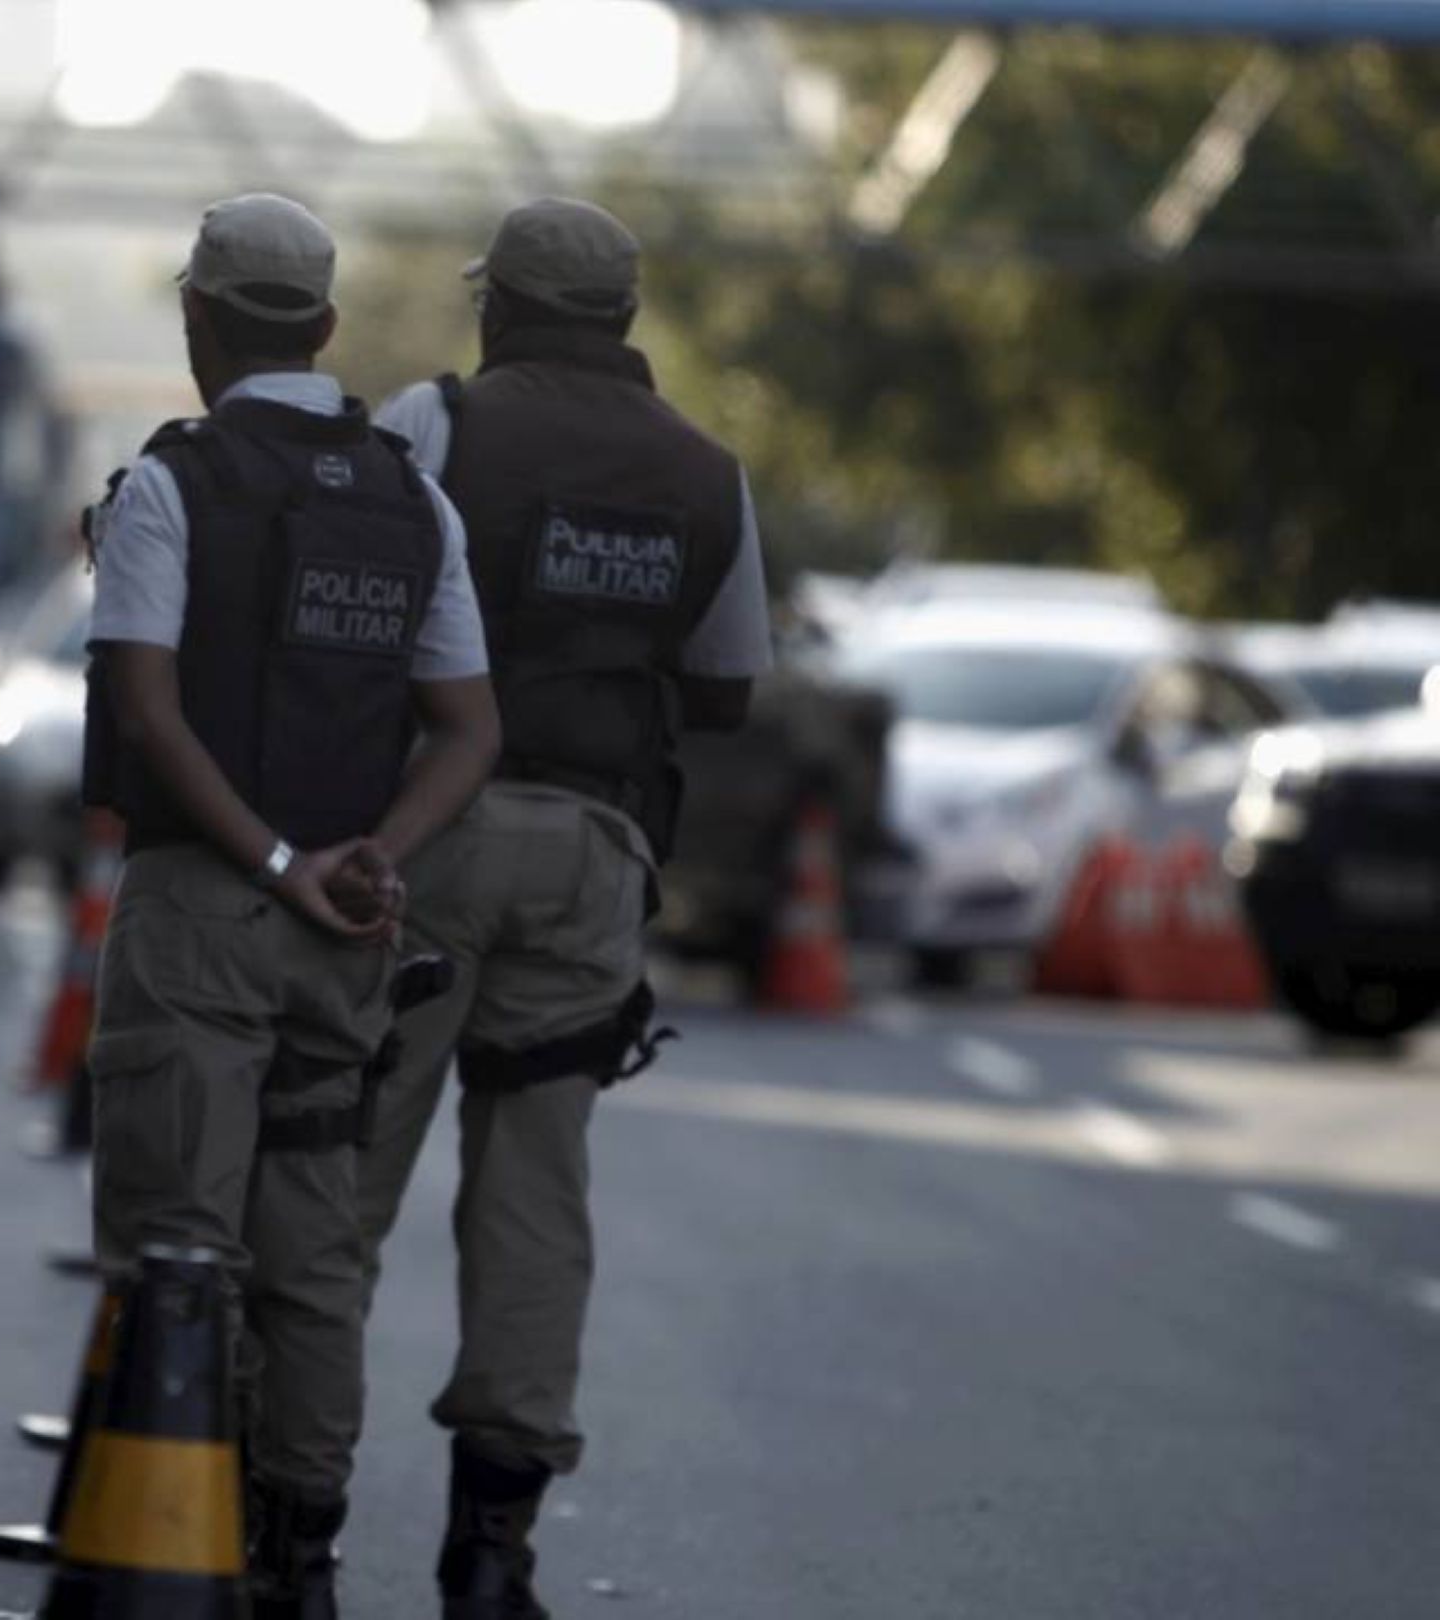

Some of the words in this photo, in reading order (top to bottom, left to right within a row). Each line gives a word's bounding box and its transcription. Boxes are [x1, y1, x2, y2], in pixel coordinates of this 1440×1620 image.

[300, 565, 408, 611] POLÍCIA
[544, 551, 673, 597] MILITAR
[294, 604, 405, 647] MILITAR
